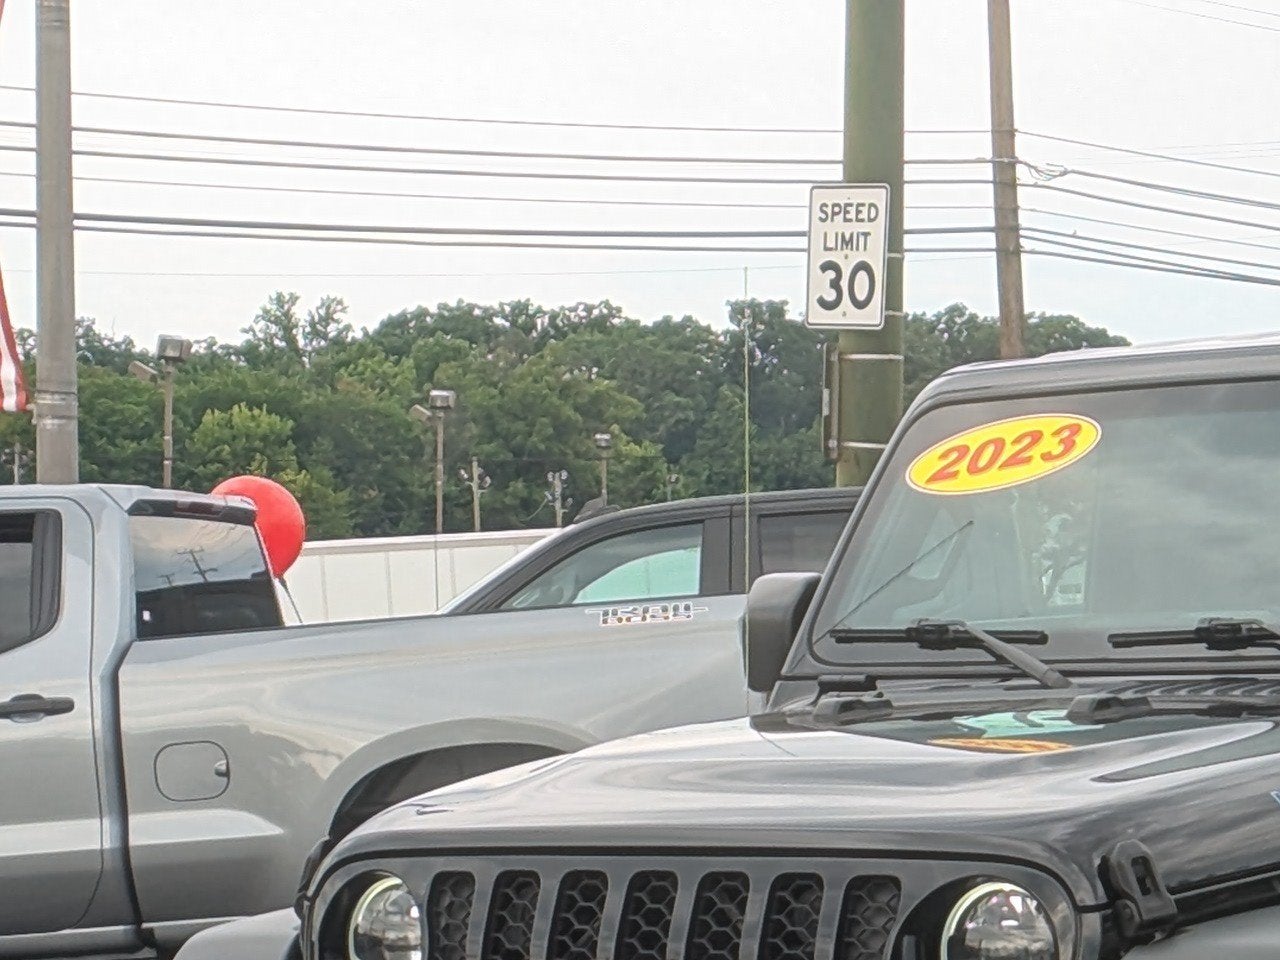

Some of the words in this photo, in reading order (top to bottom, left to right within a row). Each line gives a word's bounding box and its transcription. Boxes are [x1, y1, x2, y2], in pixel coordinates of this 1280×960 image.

[818, 202, 880, 223] SPEED
[823, 231, 872, 251] LIMIT
[816, 260, 876, 311] 30
[924, 423, 1082, 485] 2023
